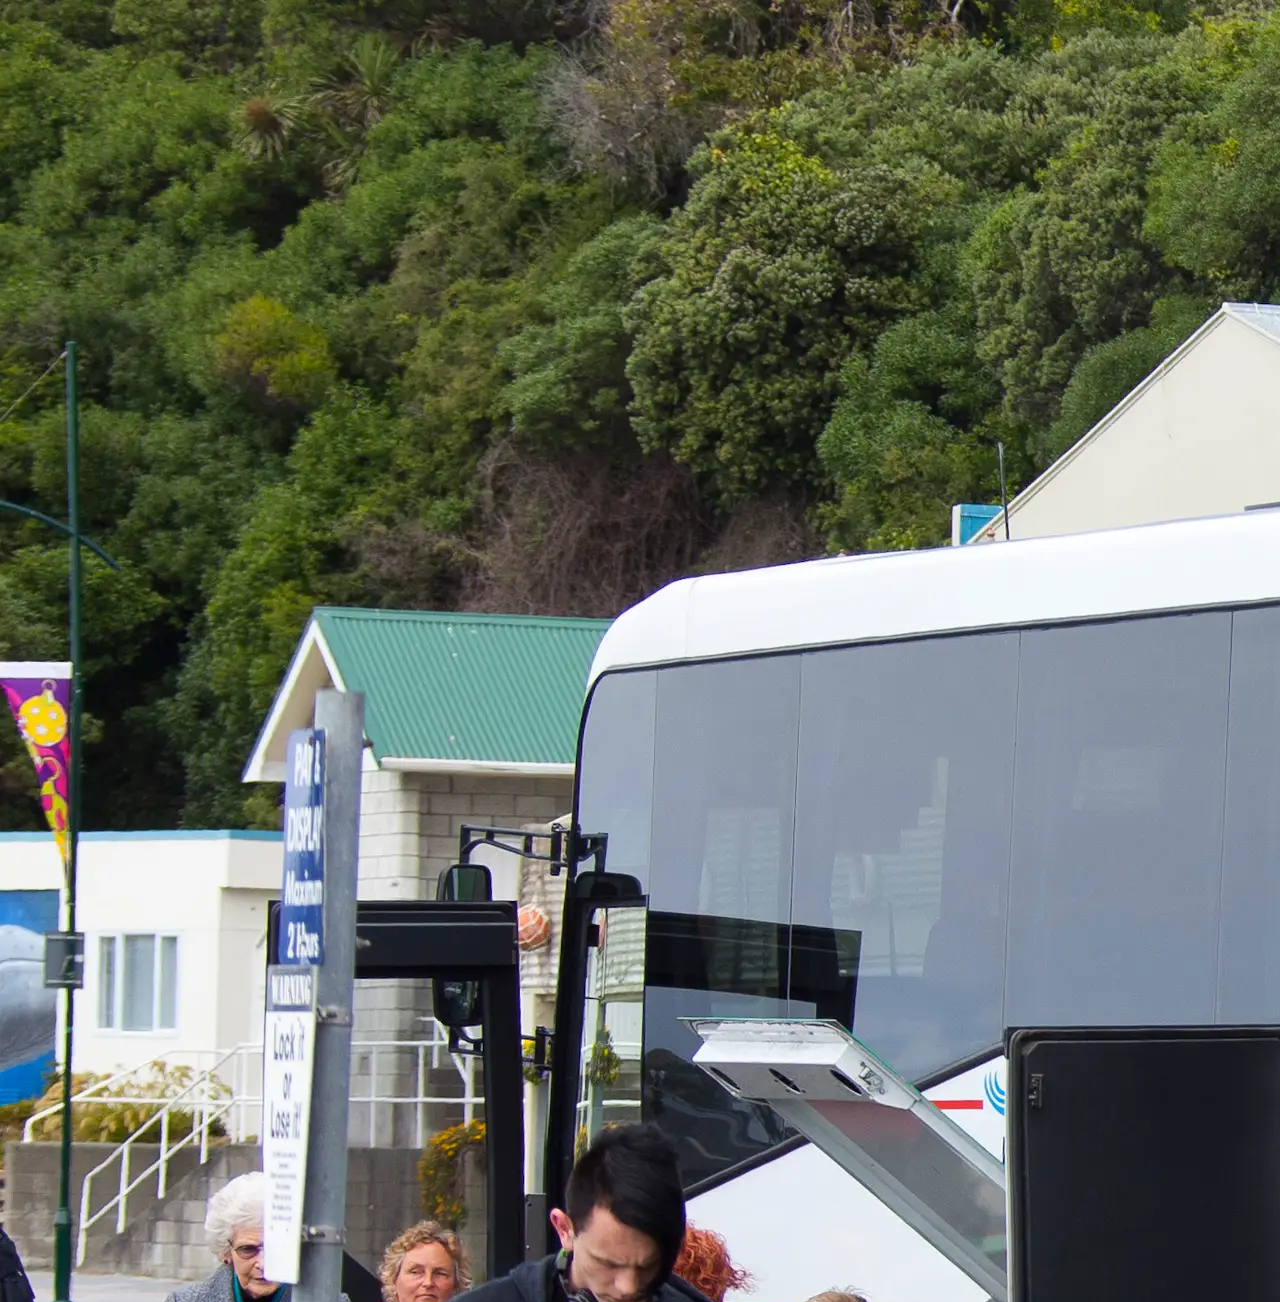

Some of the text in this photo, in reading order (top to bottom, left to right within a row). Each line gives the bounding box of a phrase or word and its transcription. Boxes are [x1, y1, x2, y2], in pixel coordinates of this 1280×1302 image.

[294, 740, 321, 787] PAY &
[287, 807, 323, 852] DISPLAY
[287, 921, 320, 959] 2 Hours
[272, 975, 311, 1005] WARNING
[273, 1021, 305, 1060] Lock it
[282, 1072, 292, 1100] or
[270, 1101, 290, 1139] Lose
